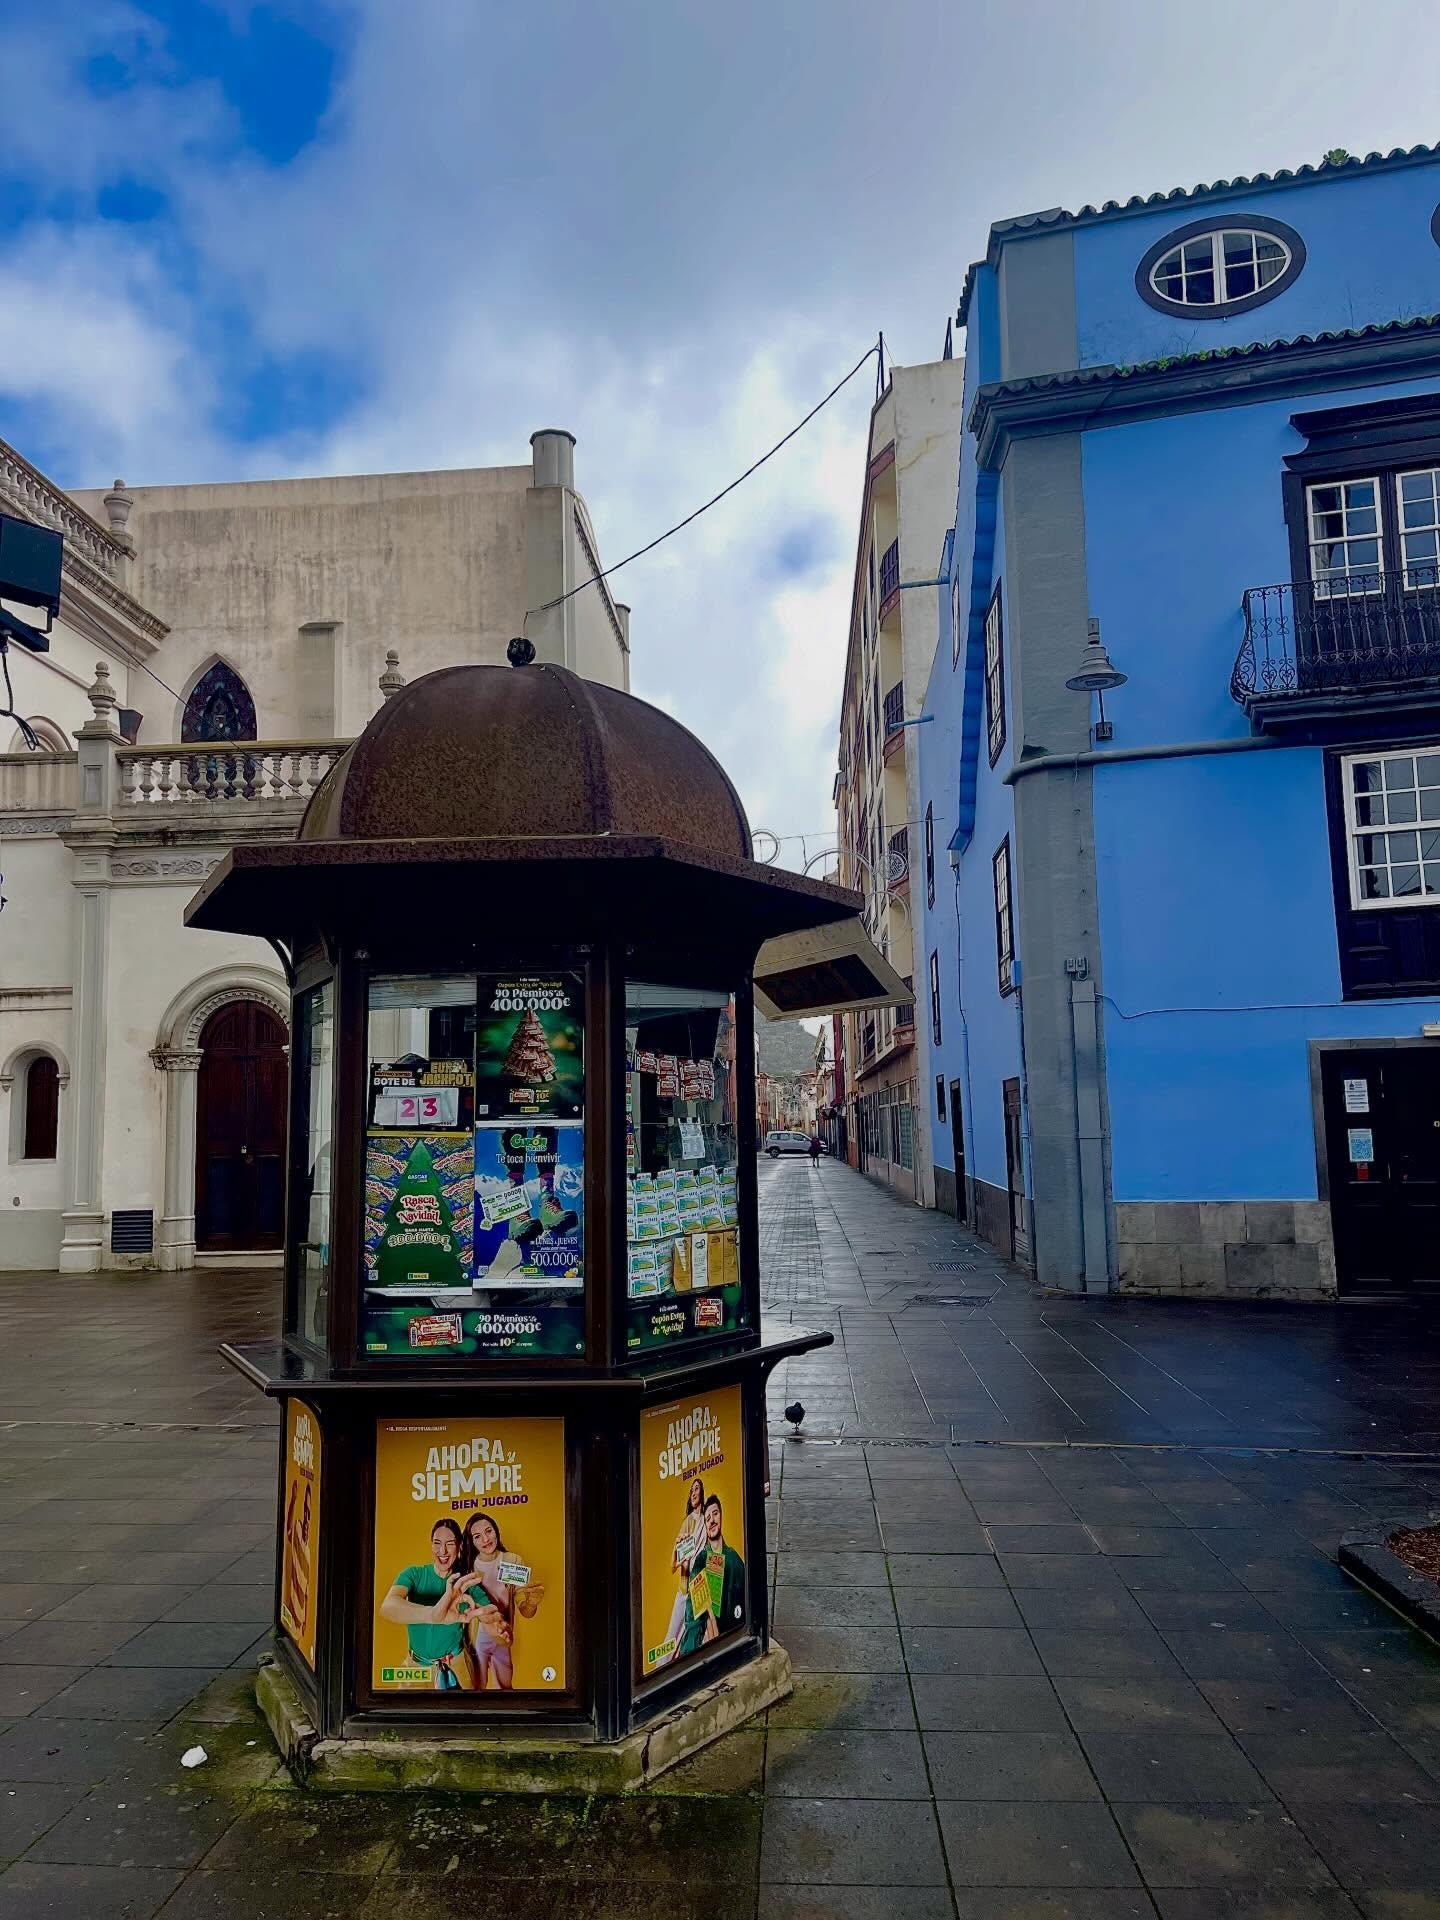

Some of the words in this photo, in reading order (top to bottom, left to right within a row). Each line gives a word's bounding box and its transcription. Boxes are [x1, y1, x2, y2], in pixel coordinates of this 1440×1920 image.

[495, 989, 510, 998] 90
[512, 988, 553, 998] Premios
[373, 1077, 400, 1086] BOTE
[401, 1078, 416, 1086] DE
[420, 1073, 472, 1086] JACKPOT
[495, 1153, 506, 1164] Te
[507, 1154, 524, 1164] toca
[400, 1195, 439, 1208] Rasca
[396, 1210, 442, 1225] Navidad
[530, 1252, 579, 1266] 500.000€
[667, 1406, 711, 1449] AHORA
[425, 1437, 505, 1472] AHORA
[658, 1426, 721, 1480] SIEMPRE
[698, 1454, 724, 1474] JUGADO
[411, 1463, 523, 1503] SIEMPRE
[451, 1500, 479, 1510] BIEN
[482, 1494, 529, 1508] JUGADO
[656, 1641, 675, 1657] ONCE
[396, 1670, 428, 1679] ONCE
